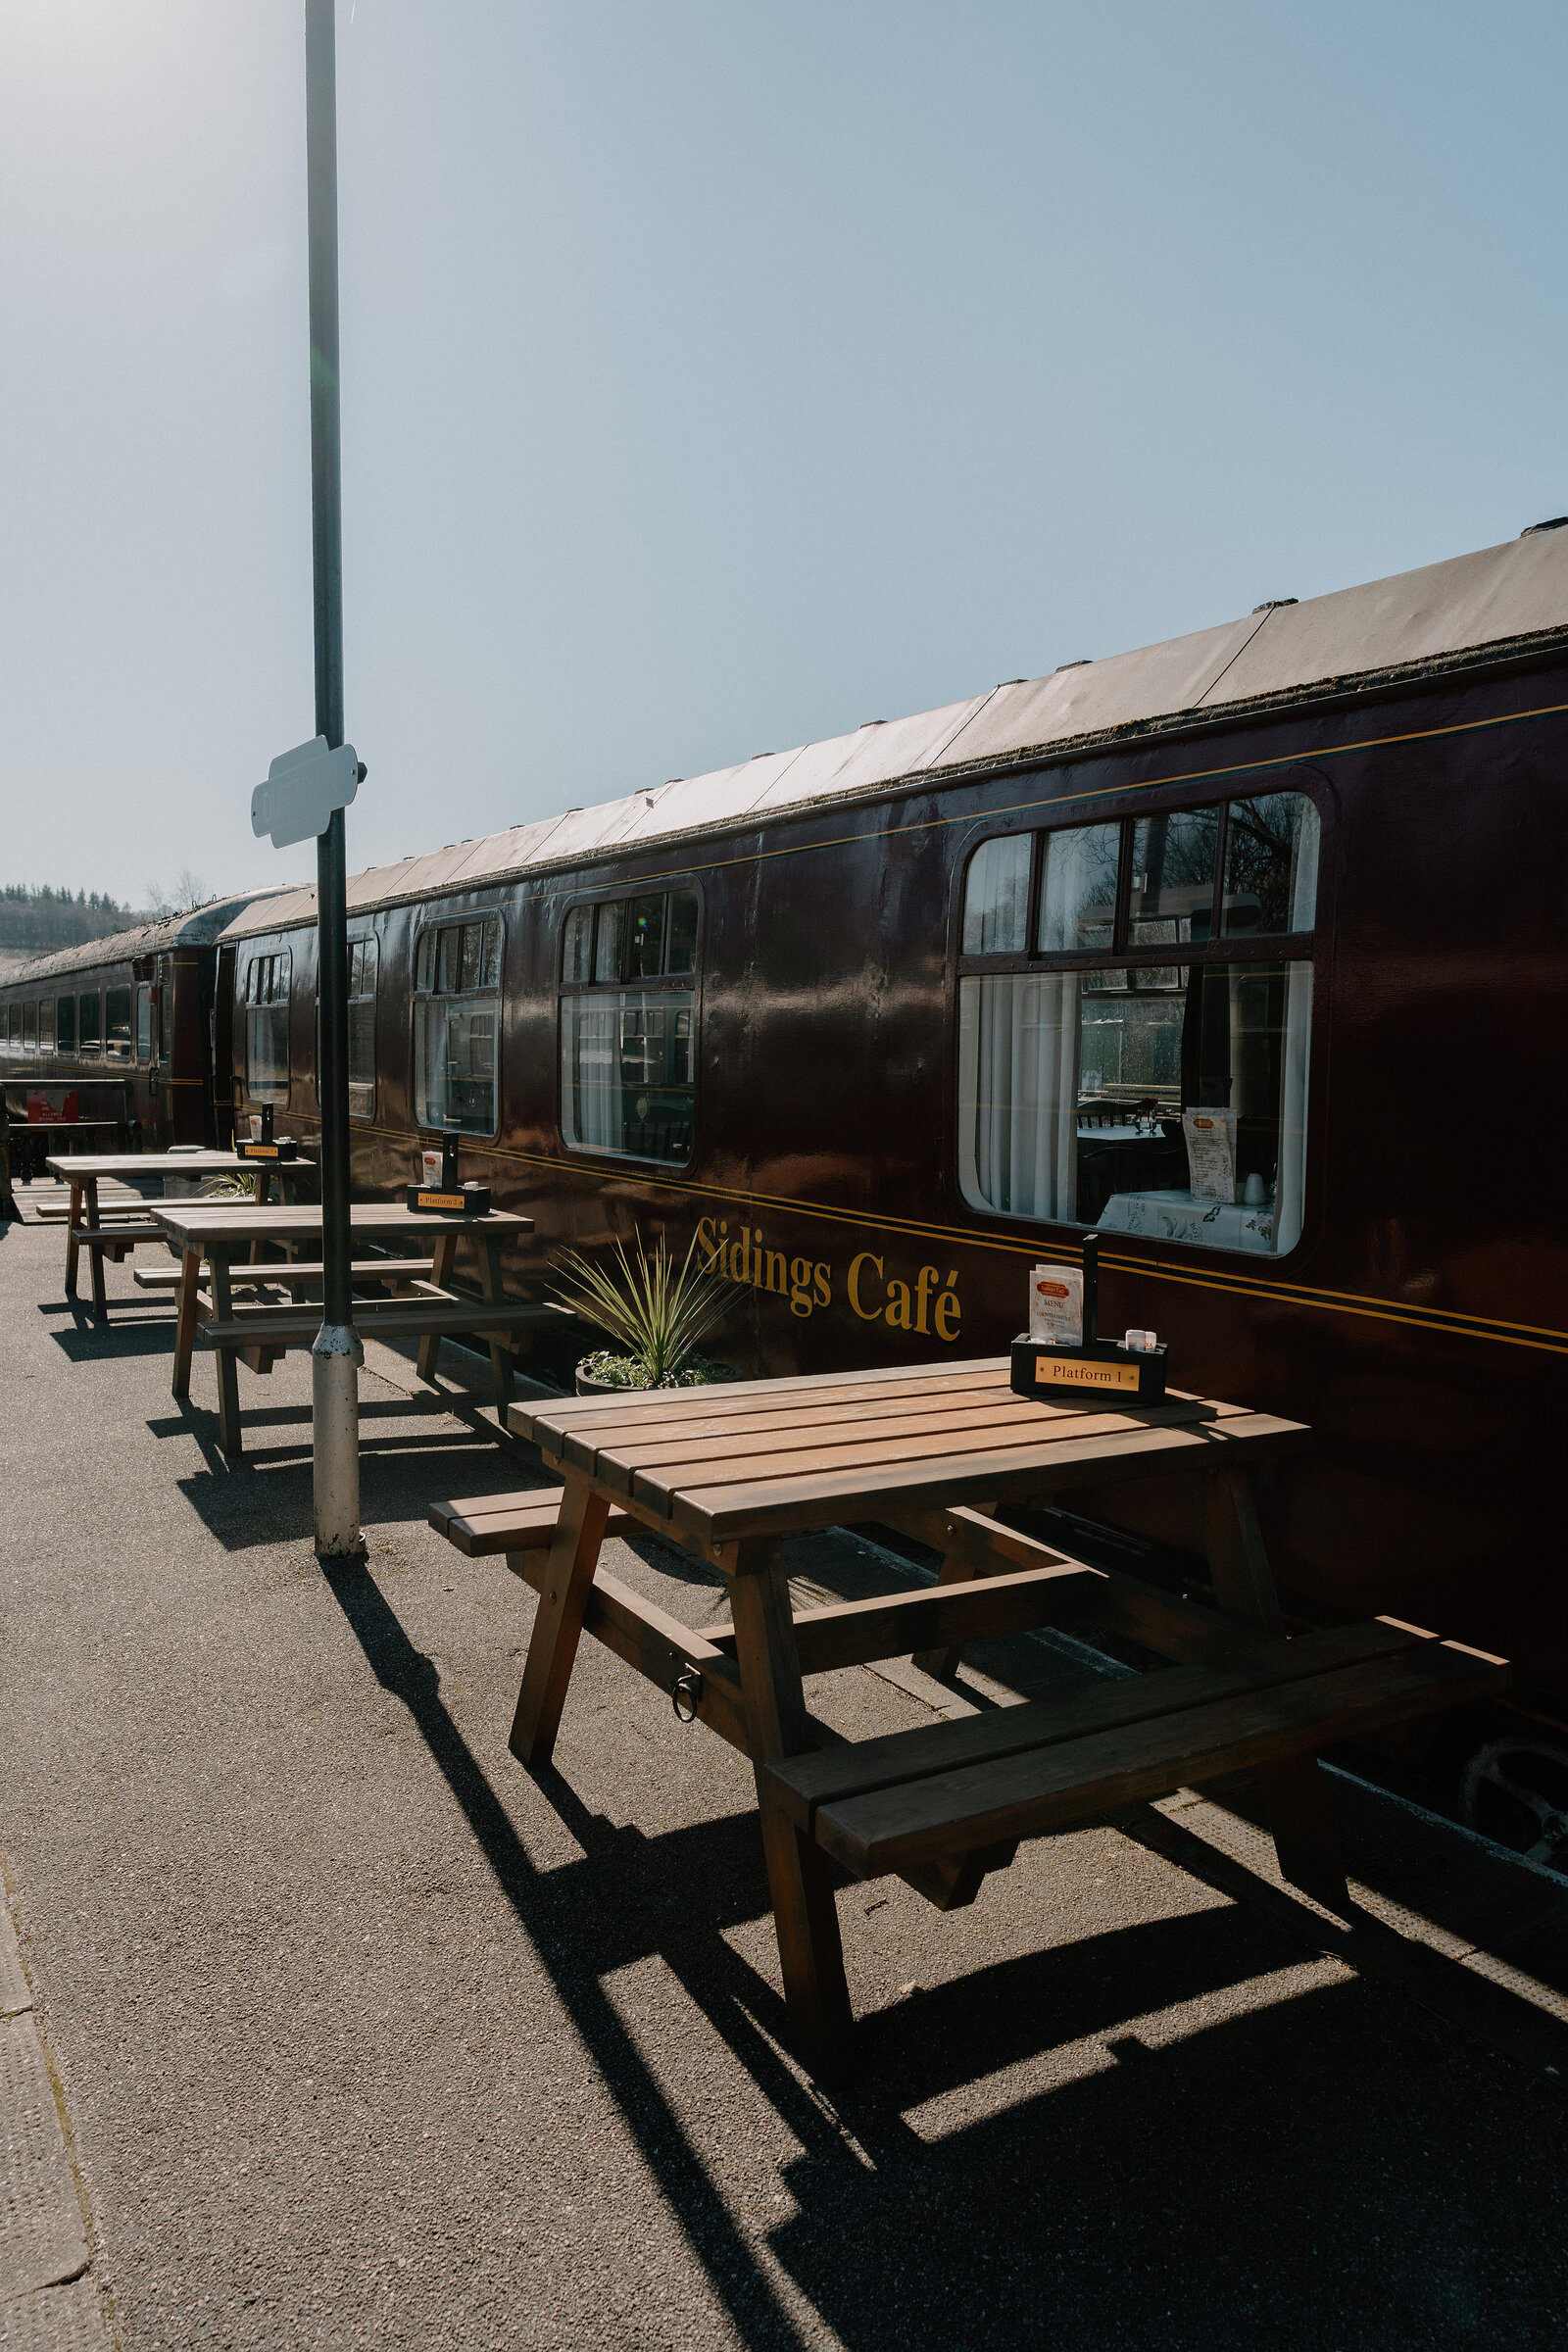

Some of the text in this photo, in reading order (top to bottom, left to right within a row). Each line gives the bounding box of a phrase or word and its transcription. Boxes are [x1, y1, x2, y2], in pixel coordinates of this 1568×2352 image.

[425, 1197, 452, 1205] Platform
[696, 1216, 962, 1342] Sidings Café
[1044, 1298, 1064, 1309] MENU
[1053, 1365, 1122, 1383] Platform 1
